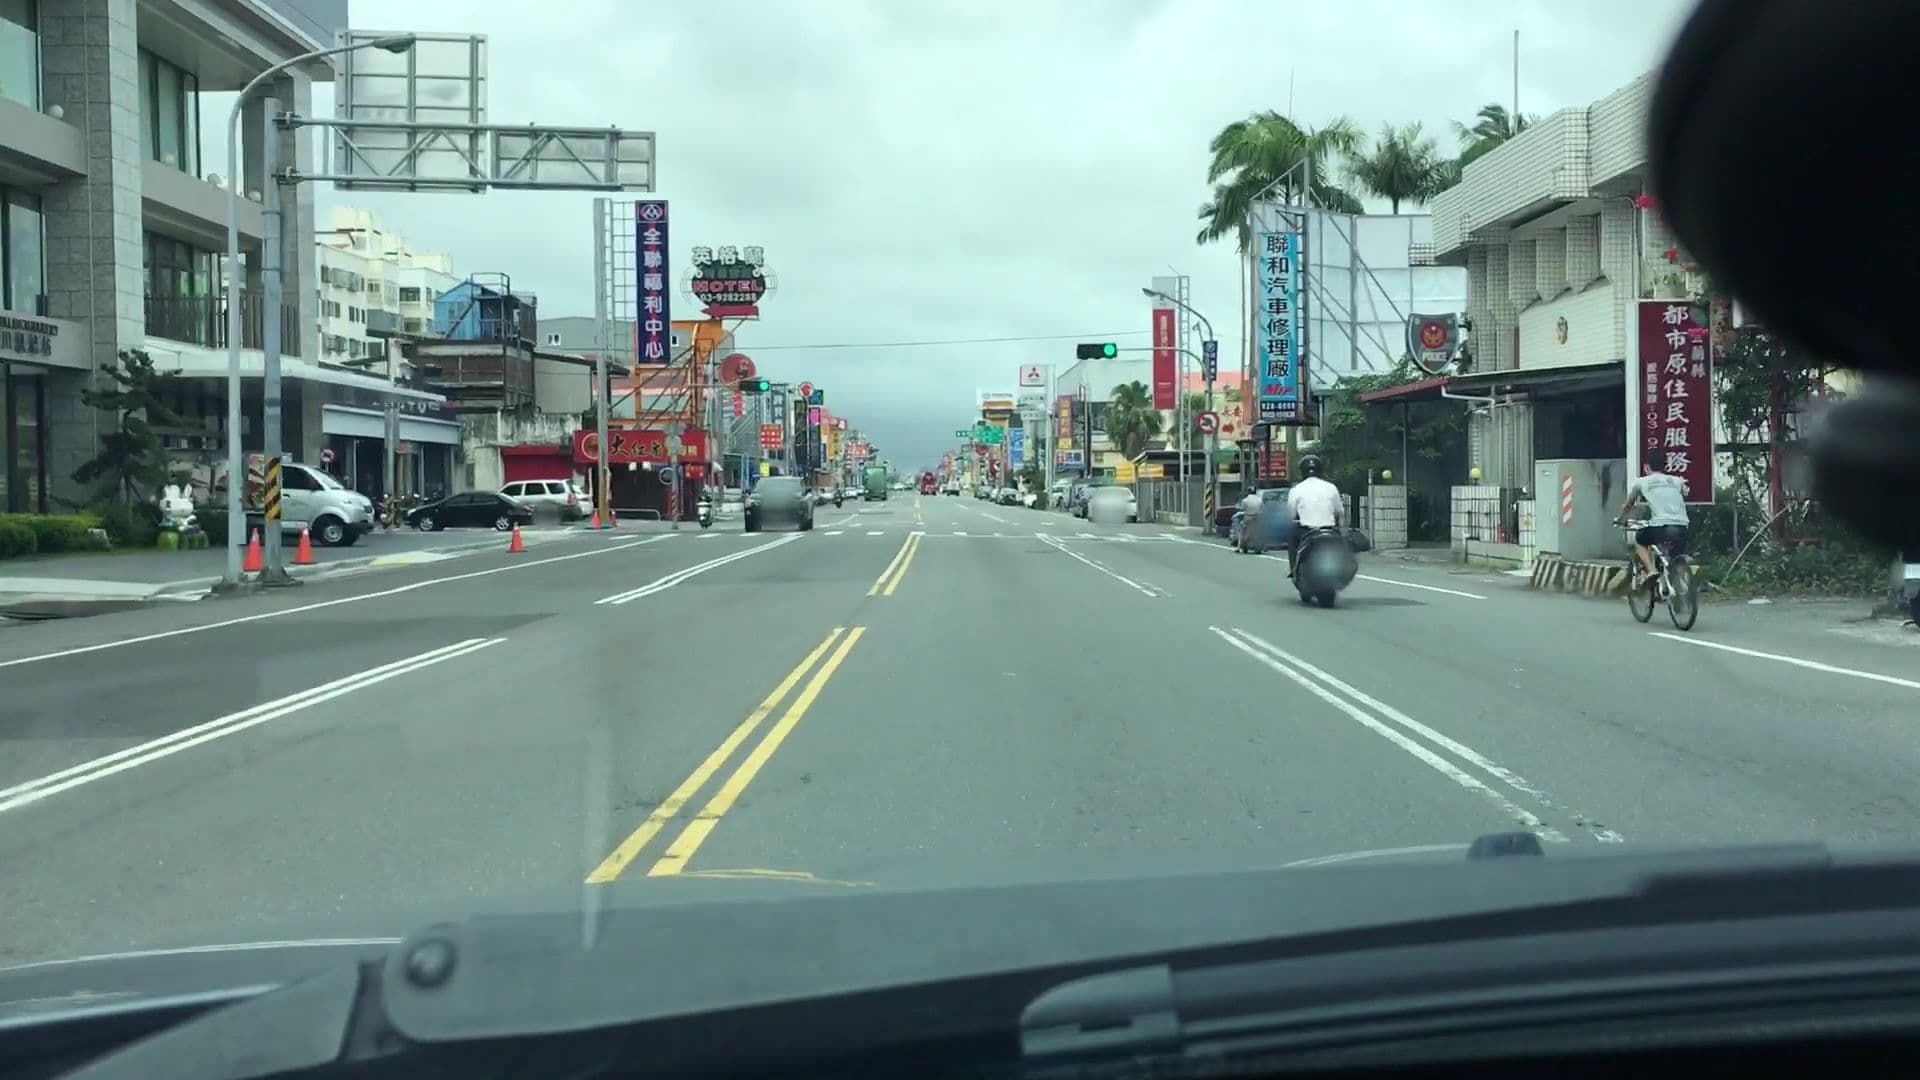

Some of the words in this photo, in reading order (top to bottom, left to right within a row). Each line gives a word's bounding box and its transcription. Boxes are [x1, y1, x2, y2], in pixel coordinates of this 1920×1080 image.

[643, 227, 664, 358] 全聯福利中心
[692, 246, 764, 267] 英格蘭
[694, 280, 763, 293] MOTEL
[1267, 235, 1289, 377] 聯和汽車修理廠
[1422, 351, 1448, 361] POLICE
[1663, 304, 1691, 497] 都市原住民服務
